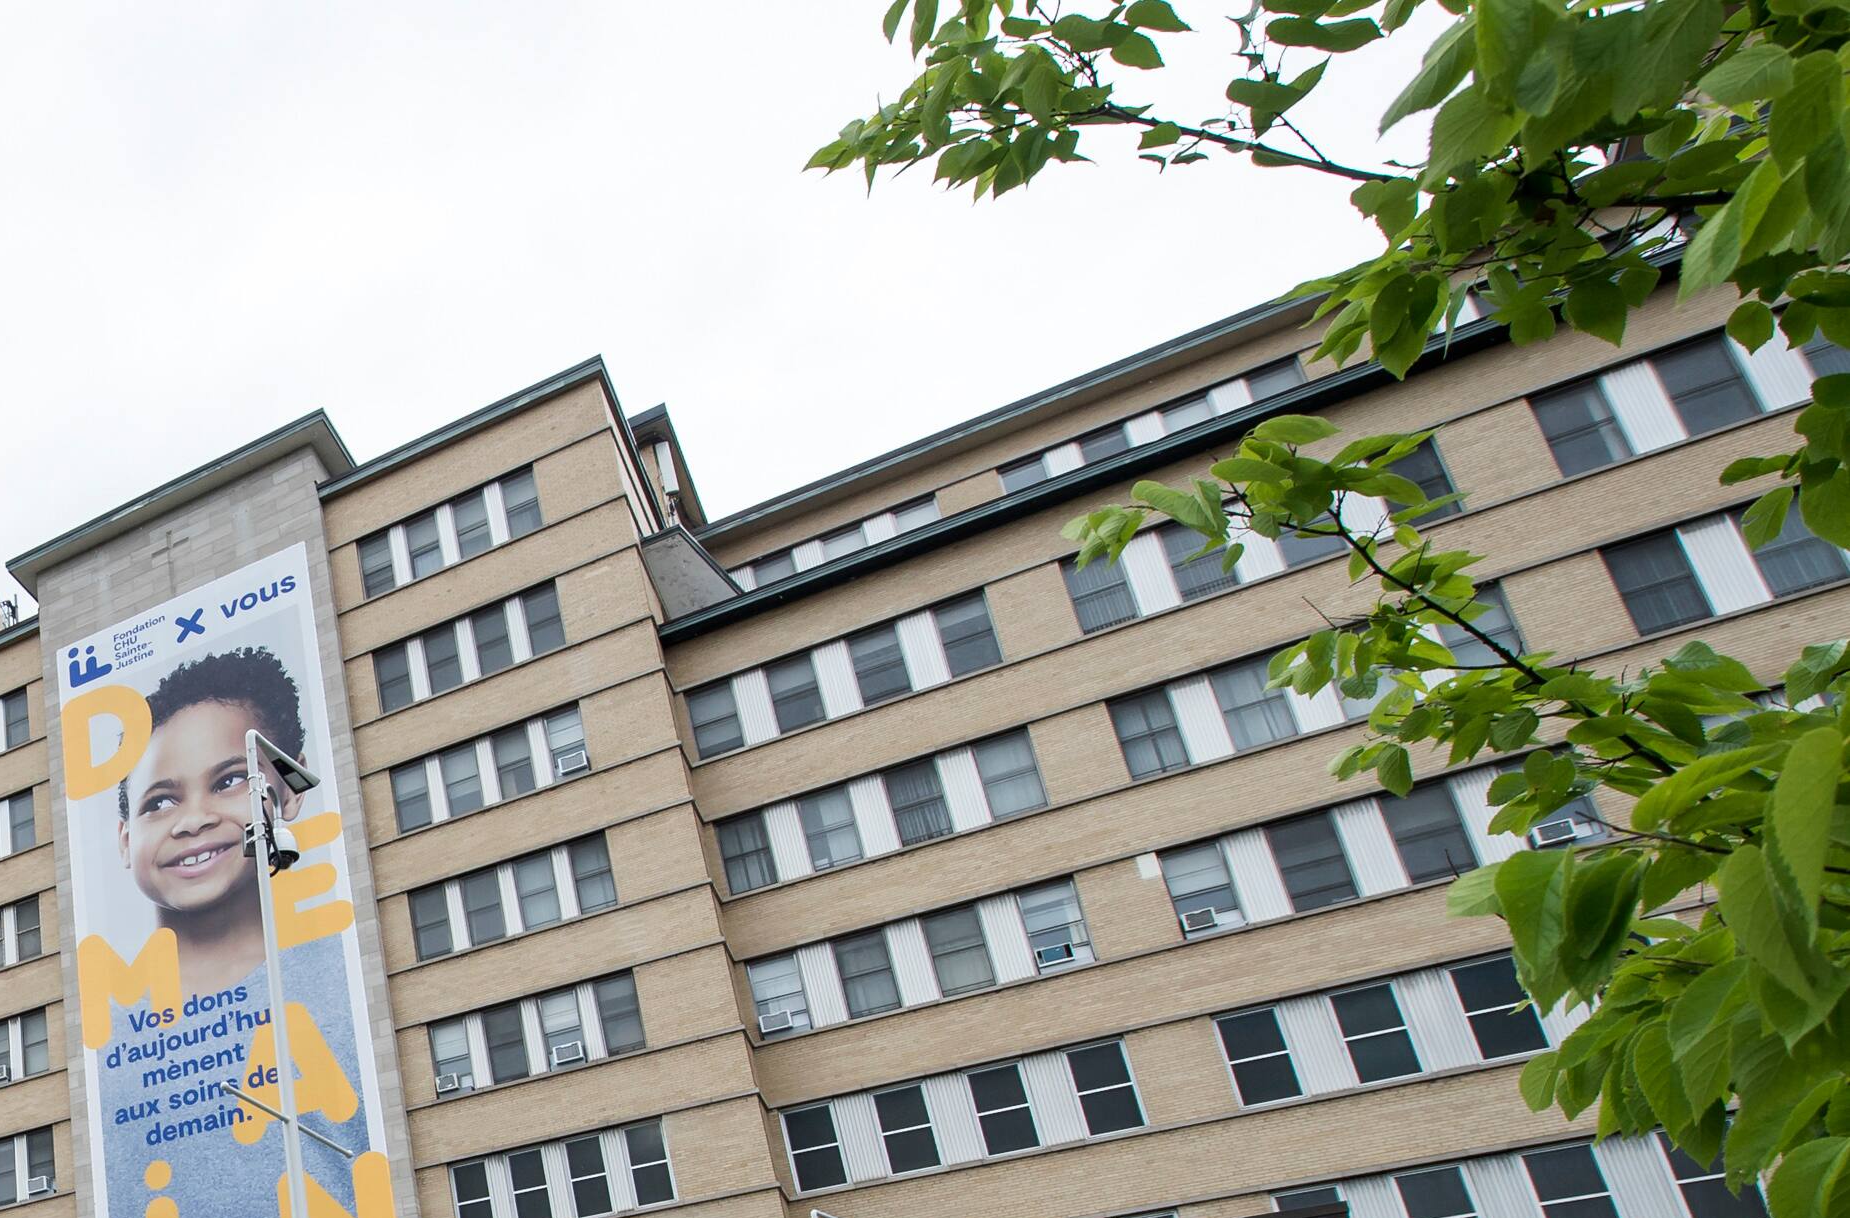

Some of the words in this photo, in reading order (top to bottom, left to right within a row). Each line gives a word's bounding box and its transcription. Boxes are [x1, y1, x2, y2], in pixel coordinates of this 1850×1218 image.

[219, 574, 297, 619] vous
[113, 615, 166, 642] Fondation
[114, 635, 138, 651] CHU
[115, 641, 153, 660] Sainte-
[116, 649, 154, 670] Justine
[128, 1007, 175, 1033] Vos
[183, 985, 248, 1017] dons
[106, 1007, 272, 1069] d'aujourd'hu
[143, 1043, 245, 1088] mènent
[115, 1098, 161, 1125] aux
[169, 1078, 240, 1110] soins
[247, 1064, 279, 1089] de
[145, 1104, 253, 1146] demain.
